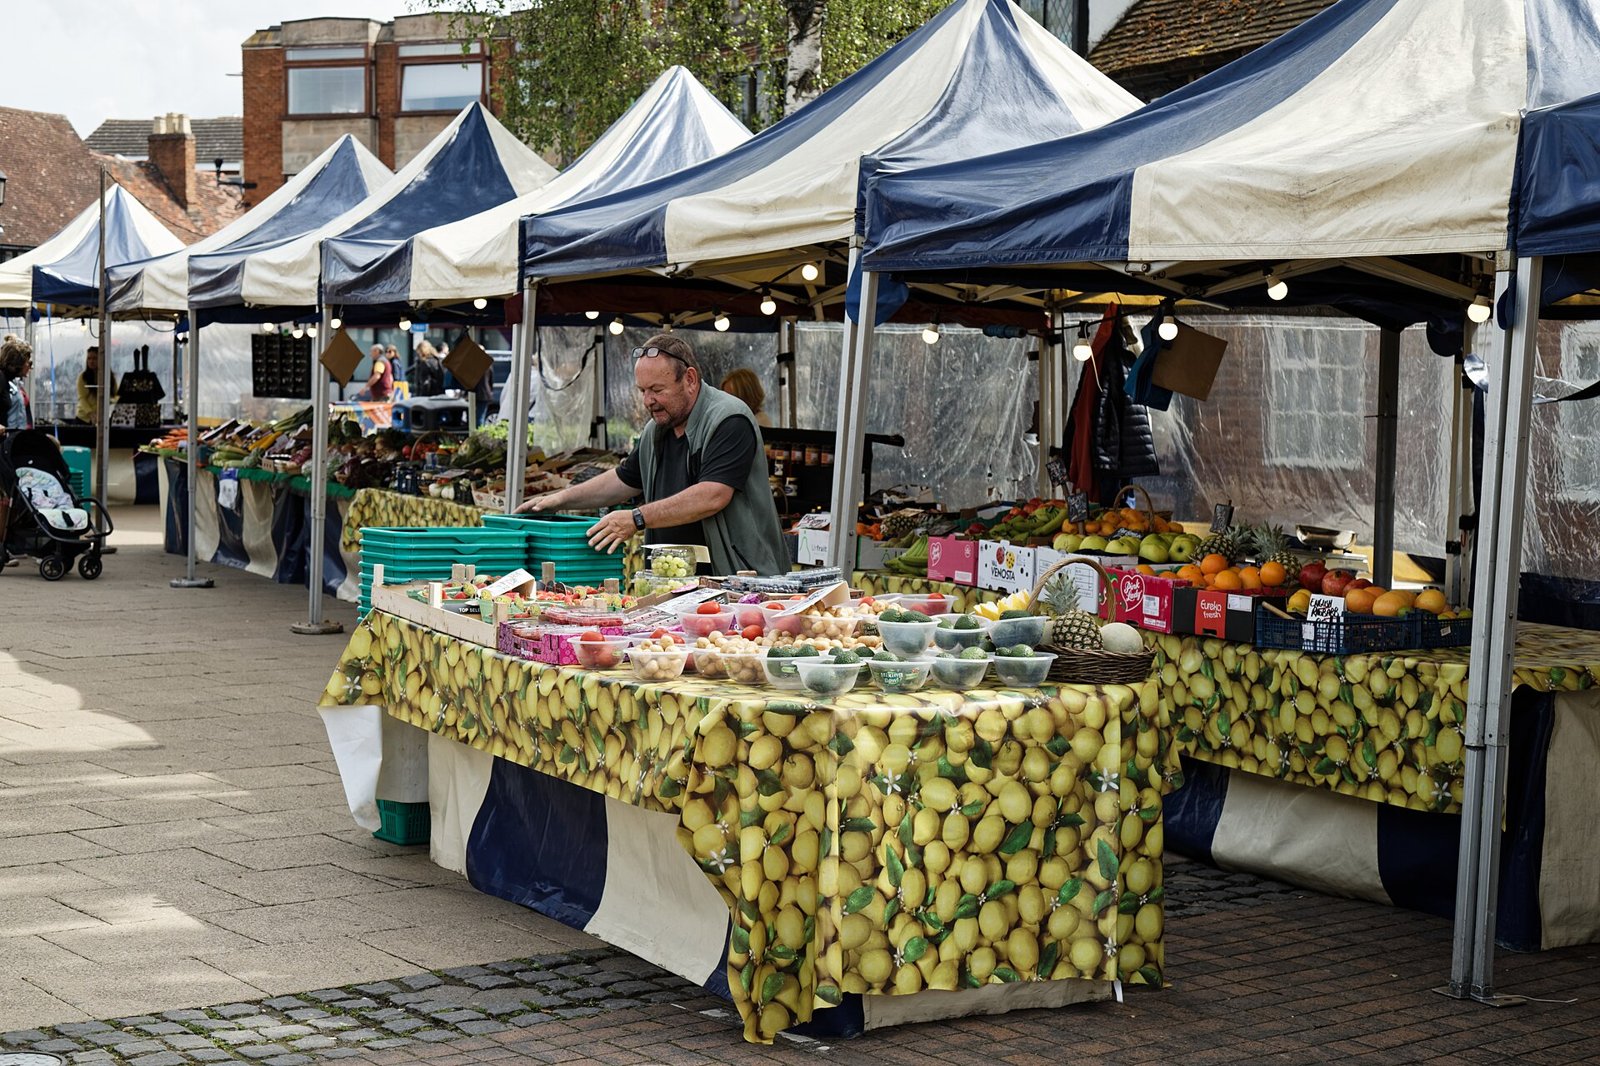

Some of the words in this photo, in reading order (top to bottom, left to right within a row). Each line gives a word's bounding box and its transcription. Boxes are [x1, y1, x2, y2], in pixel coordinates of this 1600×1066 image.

[991, 567, 1015, 580] VENOSTA
[1123, 580, 1140, 594] Pink
[1126, 590, 1143, 602] Lady
[1200, 599, 1222, 612] Eureka
